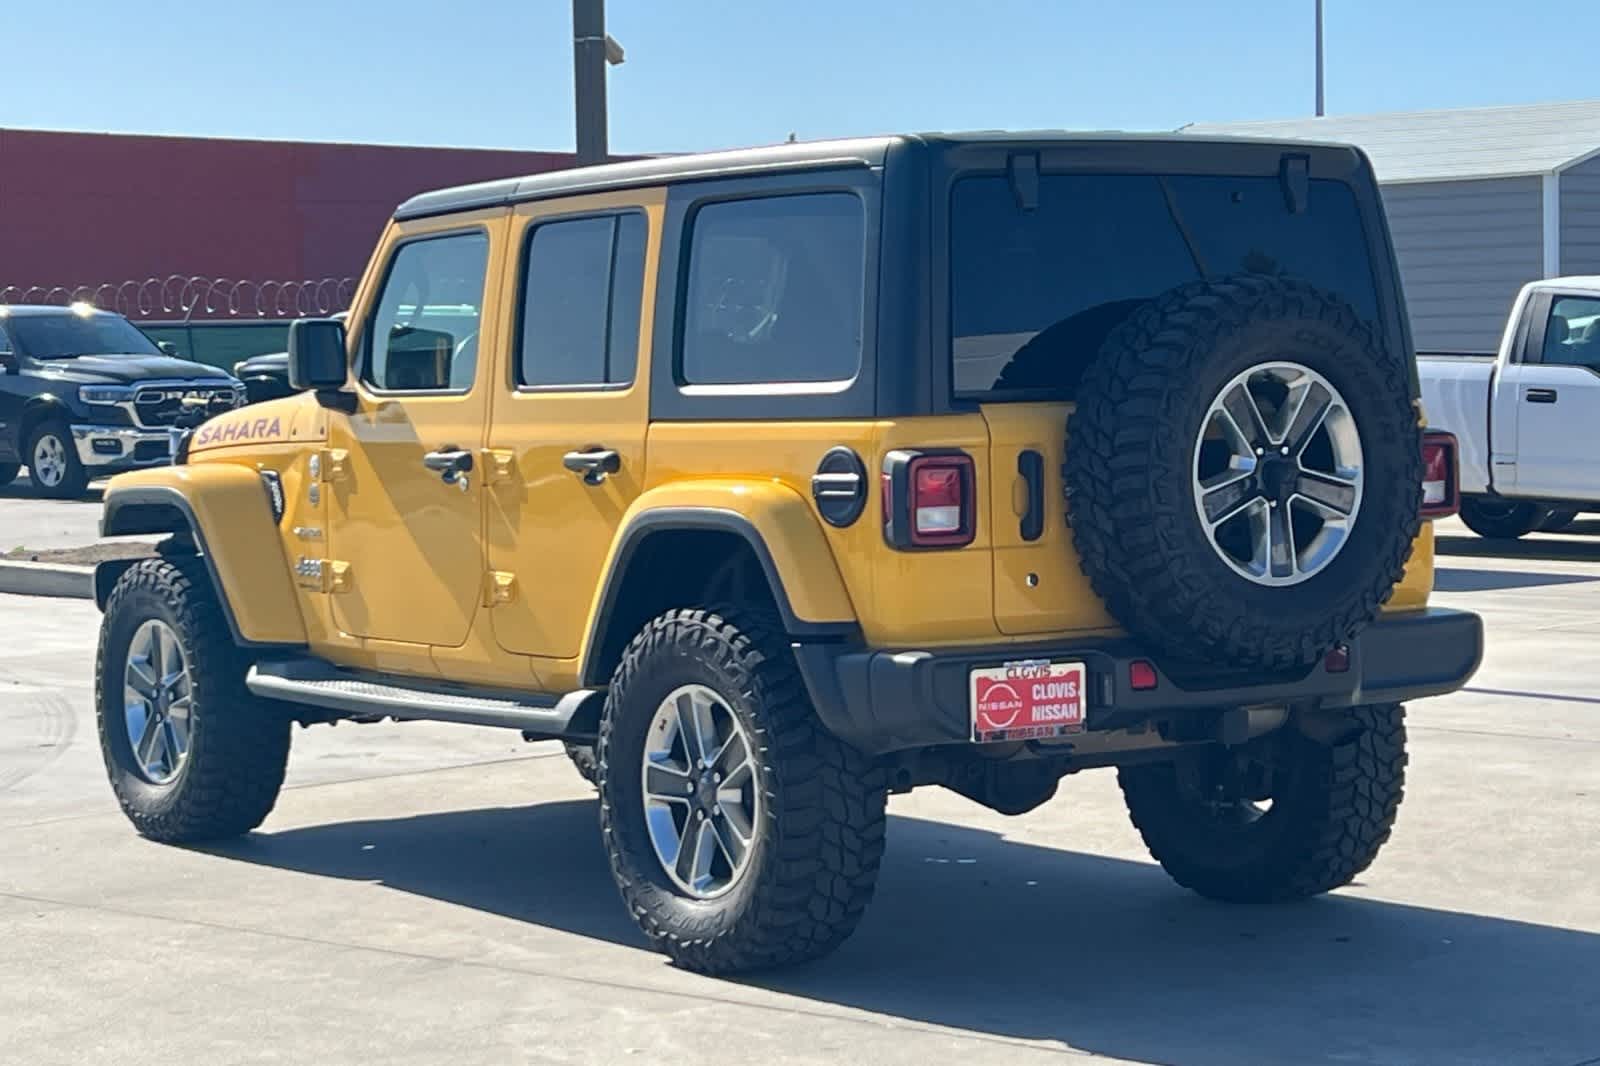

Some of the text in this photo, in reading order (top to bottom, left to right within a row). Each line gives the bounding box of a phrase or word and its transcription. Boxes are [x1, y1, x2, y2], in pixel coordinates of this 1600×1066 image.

[197, 416, 281, 446] SAHARA
[1006, 666, 1052, 679] CLOVIS
[1032, 682, 1076, 700] CLOVIS
[979, 701, 1022, 711] NISSAN
[1031, 703, 1077, 721] NISSAN
